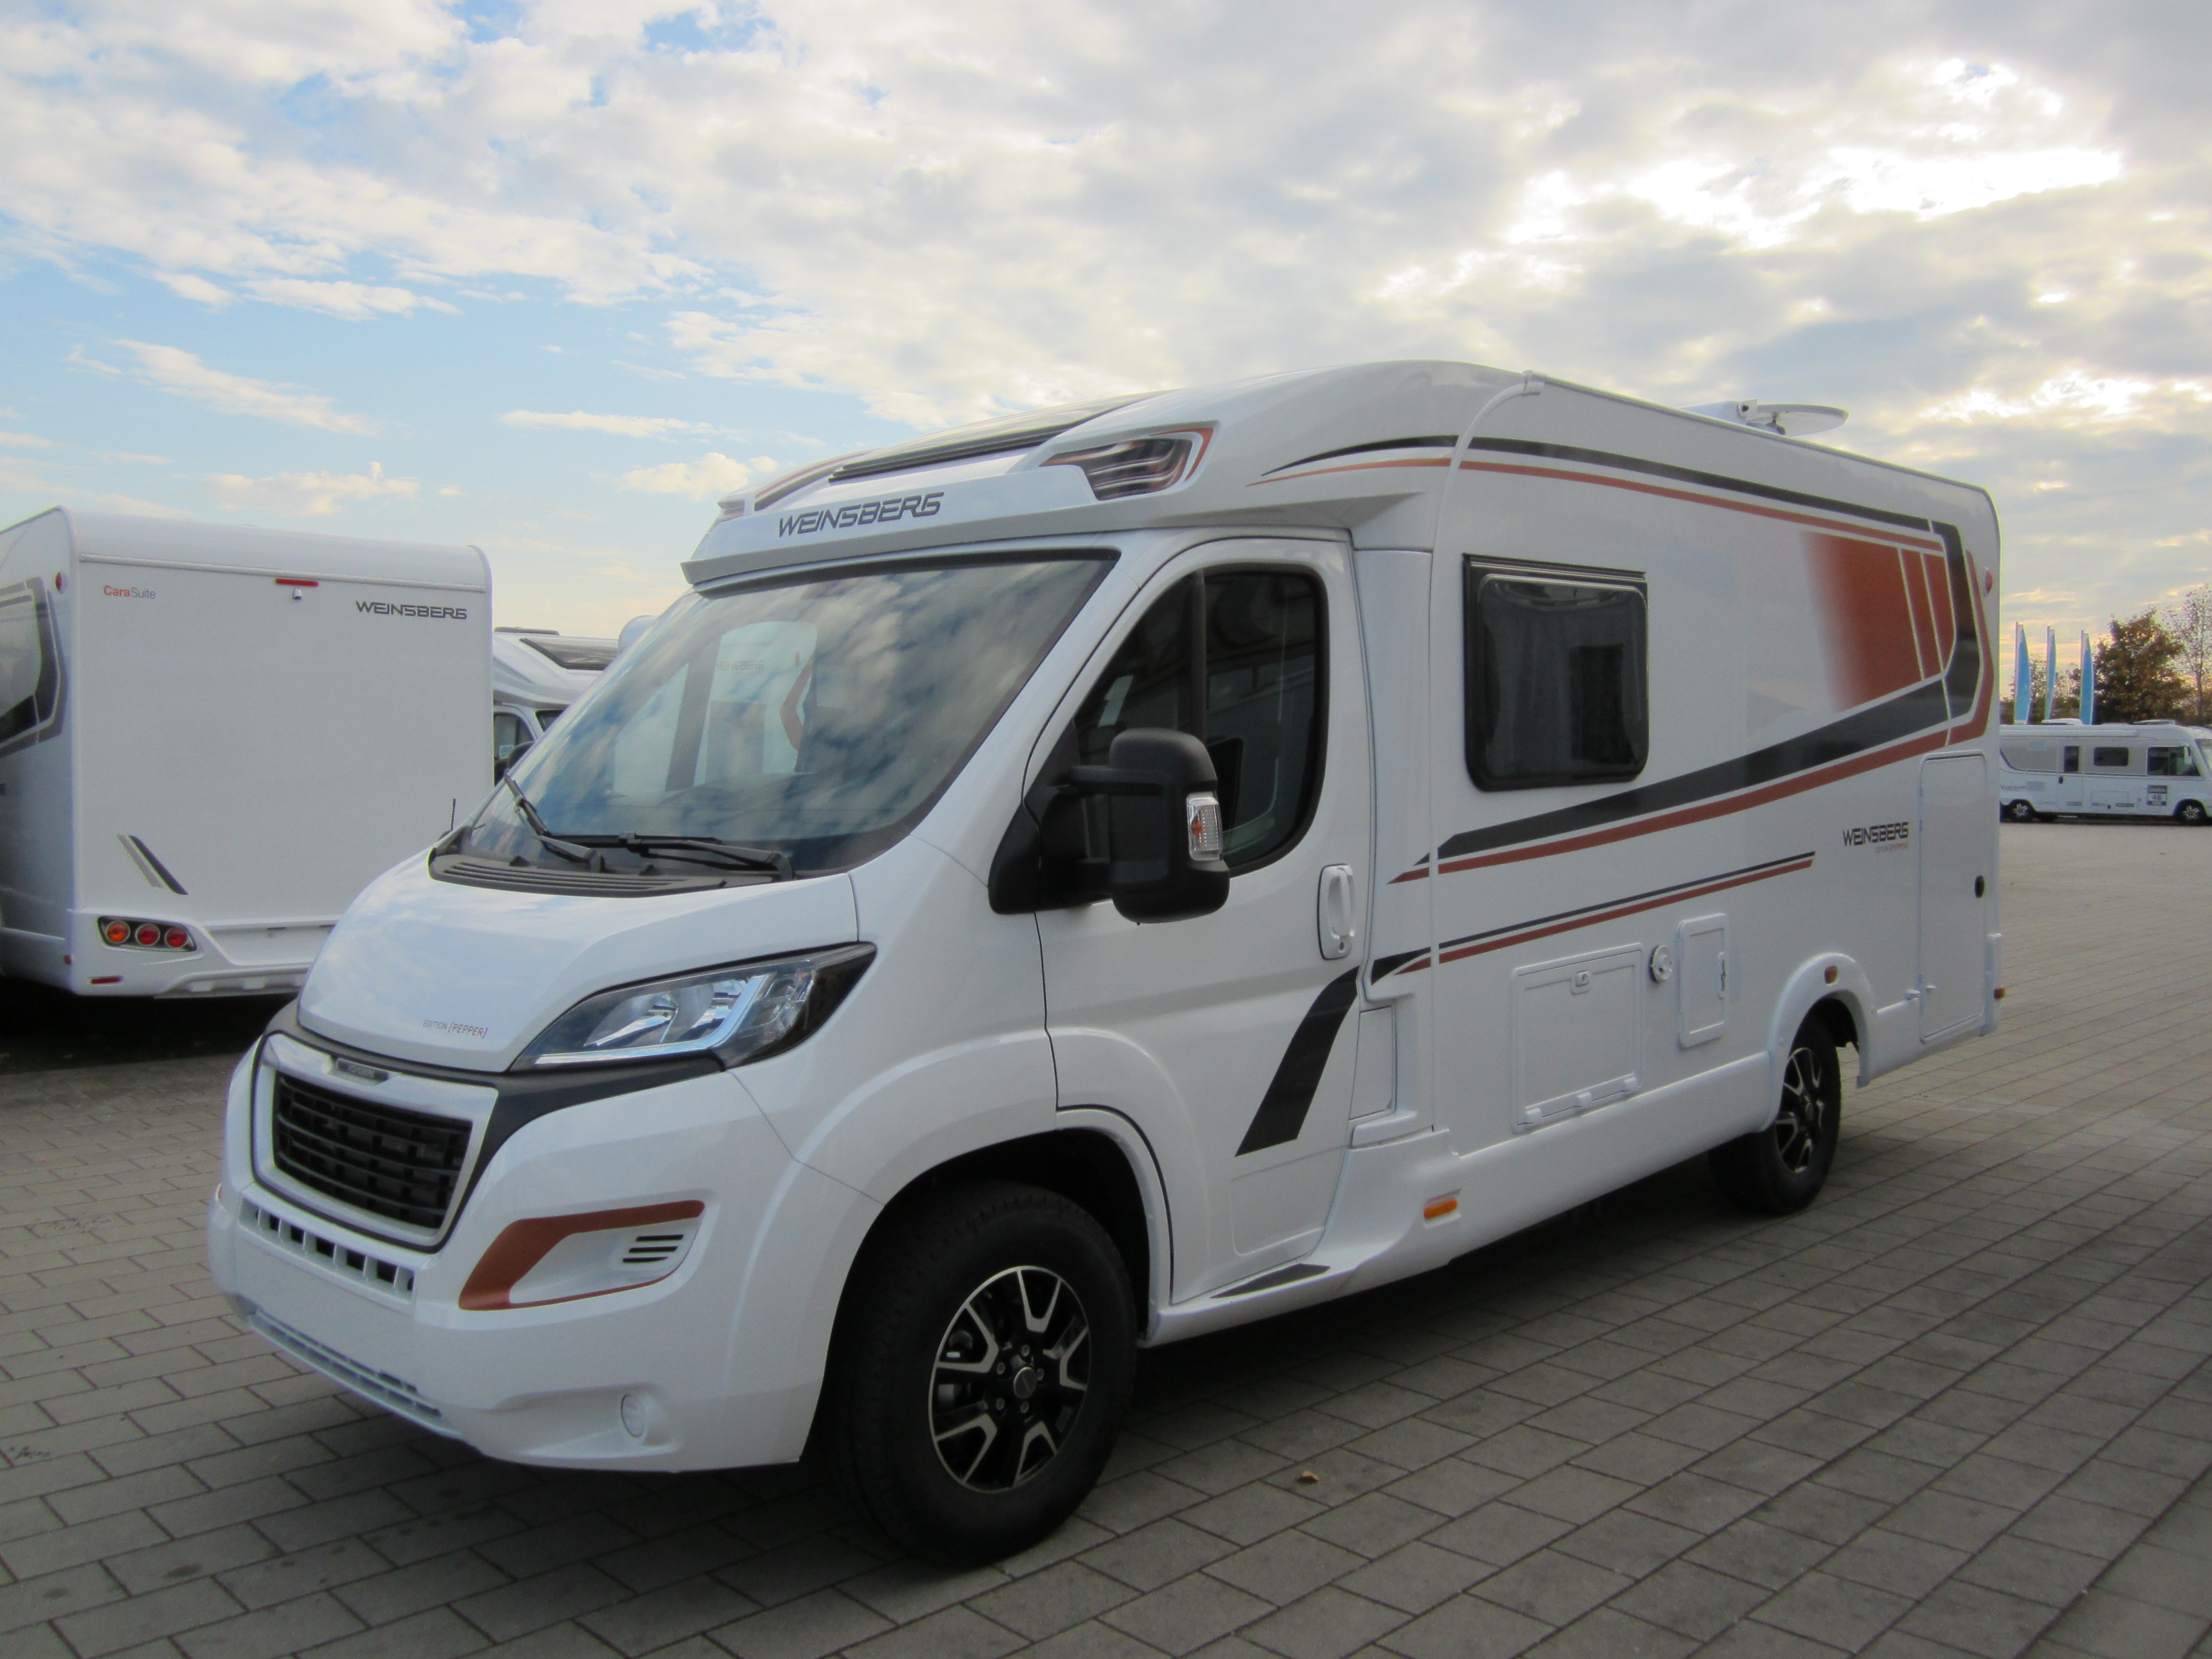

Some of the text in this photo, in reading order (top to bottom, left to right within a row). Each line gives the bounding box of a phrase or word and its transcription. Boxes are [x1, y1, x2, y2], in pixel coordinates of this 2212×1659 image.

[779, 491, 945, 537] WEINSBERG
[103, 585, 156, 599] CaraSuite
[356, 601, 467, 619] WEINSBERG
[1843, 821, 1908, 846] WEINSBERG
[422, 1019, 448, 1029] EDITION
